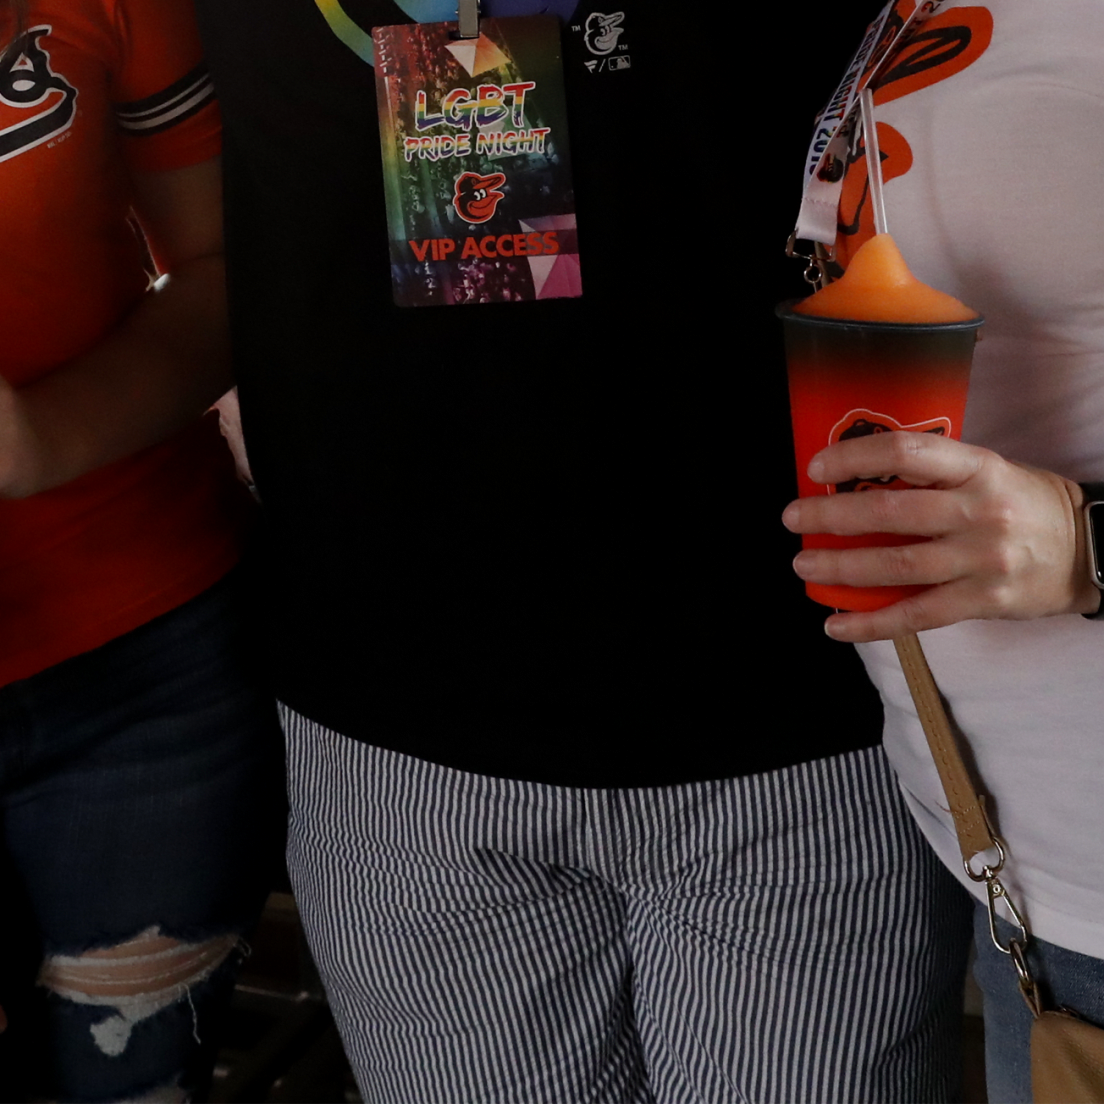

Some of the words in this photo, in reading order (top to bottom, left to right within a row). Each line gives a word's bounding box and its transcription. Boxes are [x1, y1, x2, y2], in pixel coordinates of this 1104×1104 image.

[414, 81, 536, 132] LGBT
[824, 67, 860, 121] NIGHT
[404, 133, 471, 162] PRIDE
[475, 127, 551, 157] NIGHT
[408, 238, 455, 262] VIP
[461, 231, 560, 259] ACCESS
